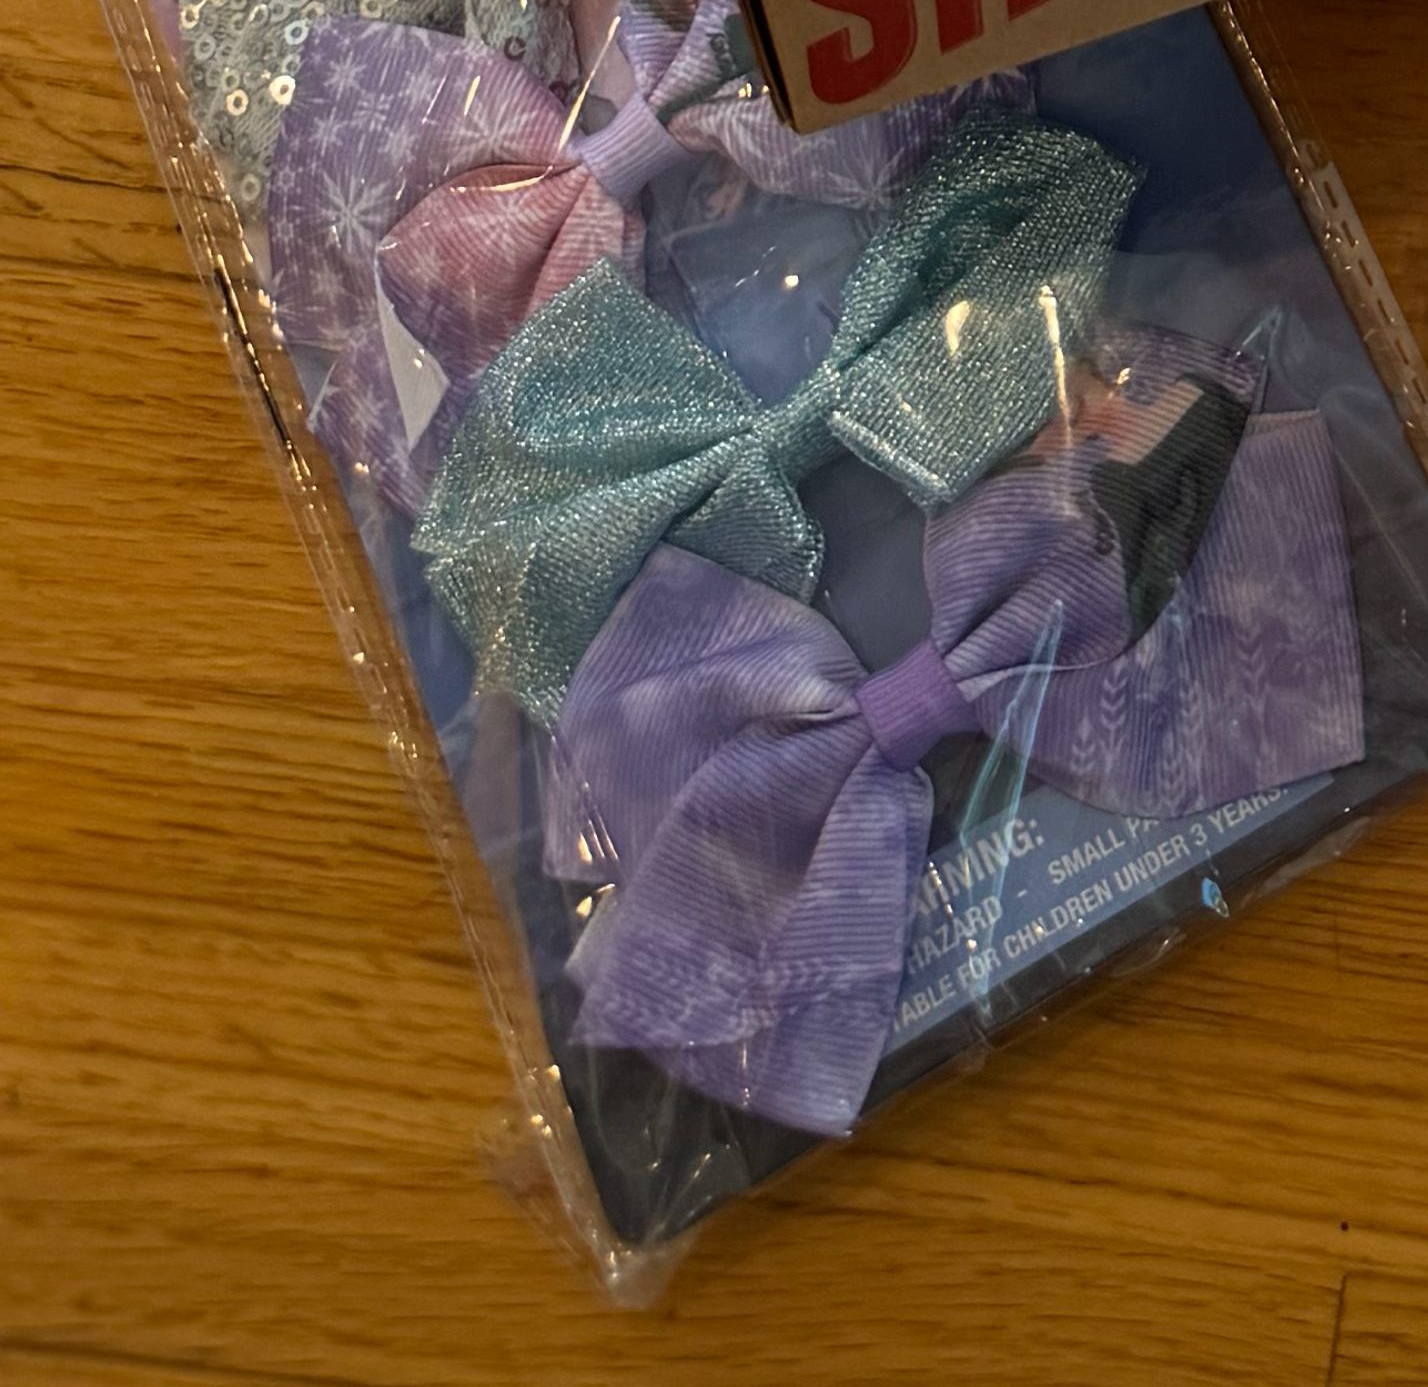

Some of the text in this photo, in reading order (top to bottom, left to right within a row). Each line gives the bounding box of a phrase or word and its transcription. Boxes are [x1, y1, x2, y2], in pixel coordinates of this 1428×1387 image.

[906, 828, 1126, 976] HAZARD SMALL
[956, 947, 1002, 990] FOR
[1002, 880, 1114, 959] CHILDREN
[1114, 834, 1191, 892] UNDER
[1189, 823, 1208, 847] 3
